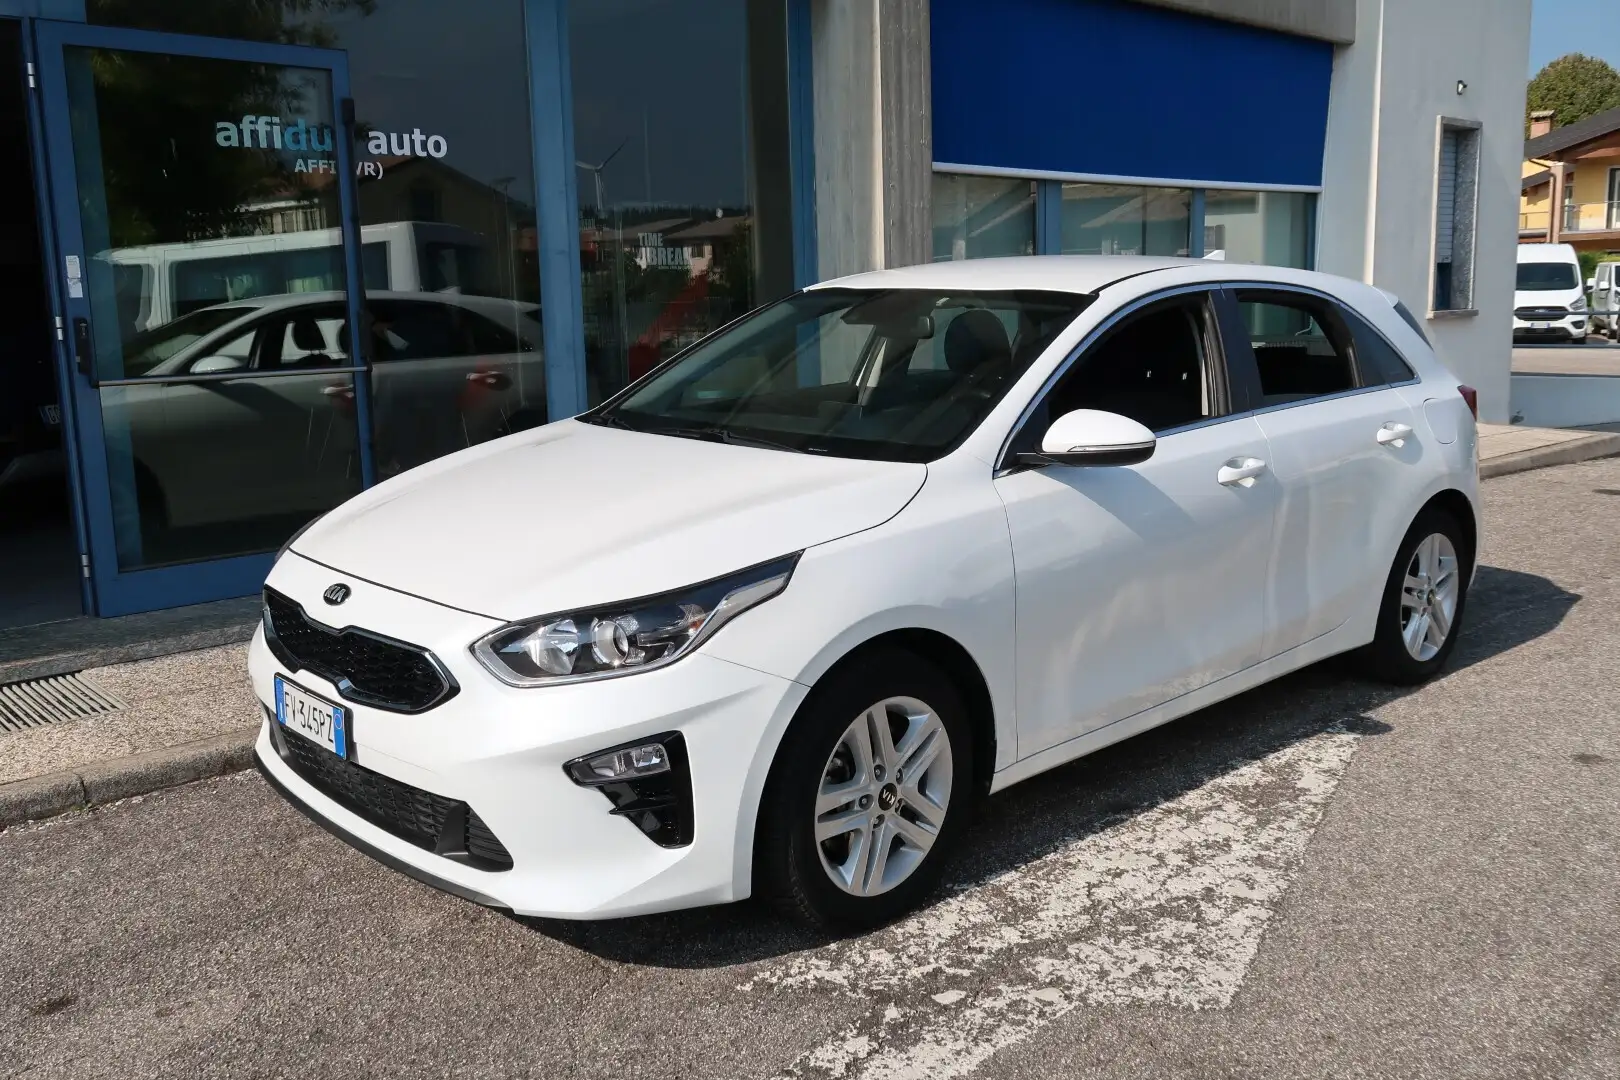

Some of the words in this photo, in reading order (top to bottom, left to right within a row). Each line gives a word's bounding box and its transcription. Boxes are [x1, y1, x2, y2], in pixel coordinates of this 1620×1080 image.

[215, 114, 333, 152] affidu
[367, 128, 448, 158] auto
[294, 158, 336, 174] AFFI
[637, 232, 663, 247] TIME
[324, 584, 347, 603] KIA
